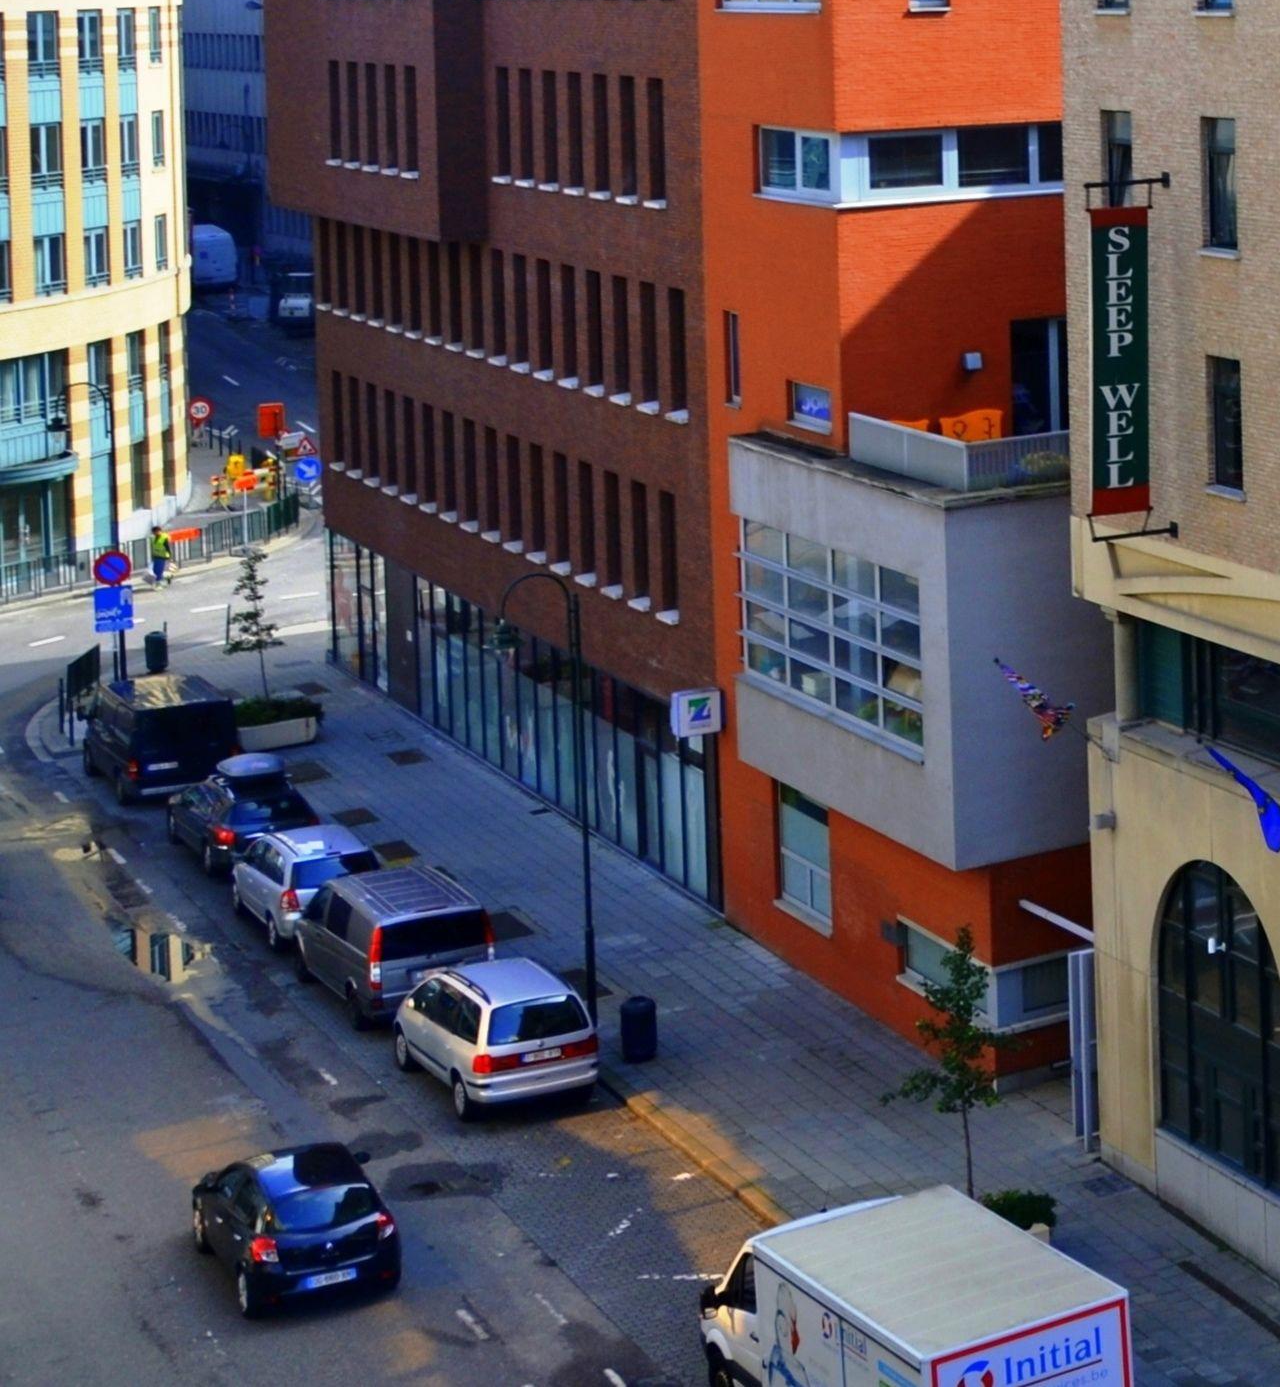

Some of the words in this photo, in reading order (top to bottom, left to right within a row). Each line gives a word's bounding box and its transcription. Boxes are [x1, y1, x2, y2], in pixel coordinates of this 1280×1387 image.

[1105, 226, 1133, 357] SLEEP
[192, 405, 208, 416] 30
[1099, 383, 1140, 489] WELL
[1004, 1326, 1103, 1386] Initial
